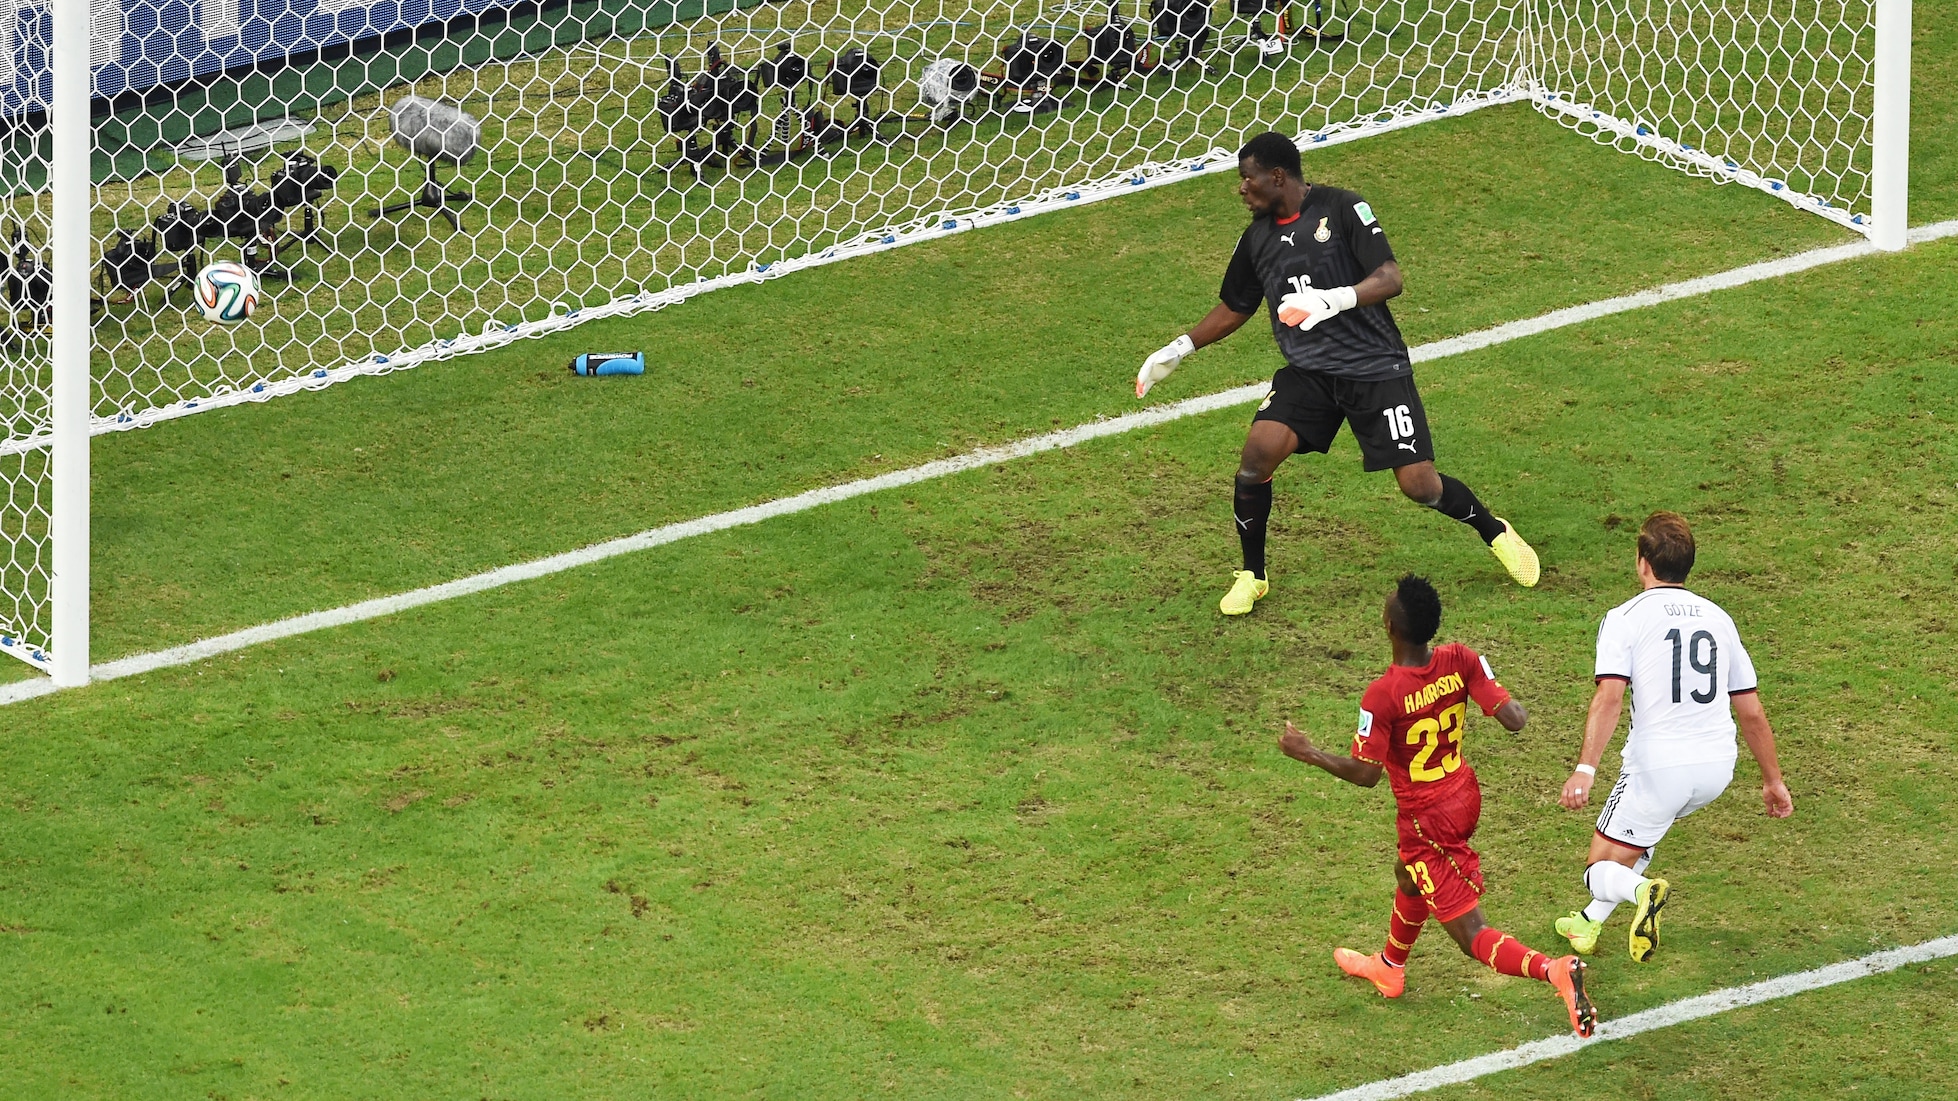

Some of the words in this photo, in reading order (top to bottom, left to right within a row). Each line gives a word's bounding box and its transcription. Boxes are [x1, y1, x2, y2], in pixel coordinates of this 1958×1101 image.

[1382, 404, 1415, 441] 16
[1663, 603, 1704, 618] GÖTZE
[1663, 628, 1718, 705] 19
[1404, 671, 1465, 715] HARRISON
[1405, 701, 1466, 783] 23
